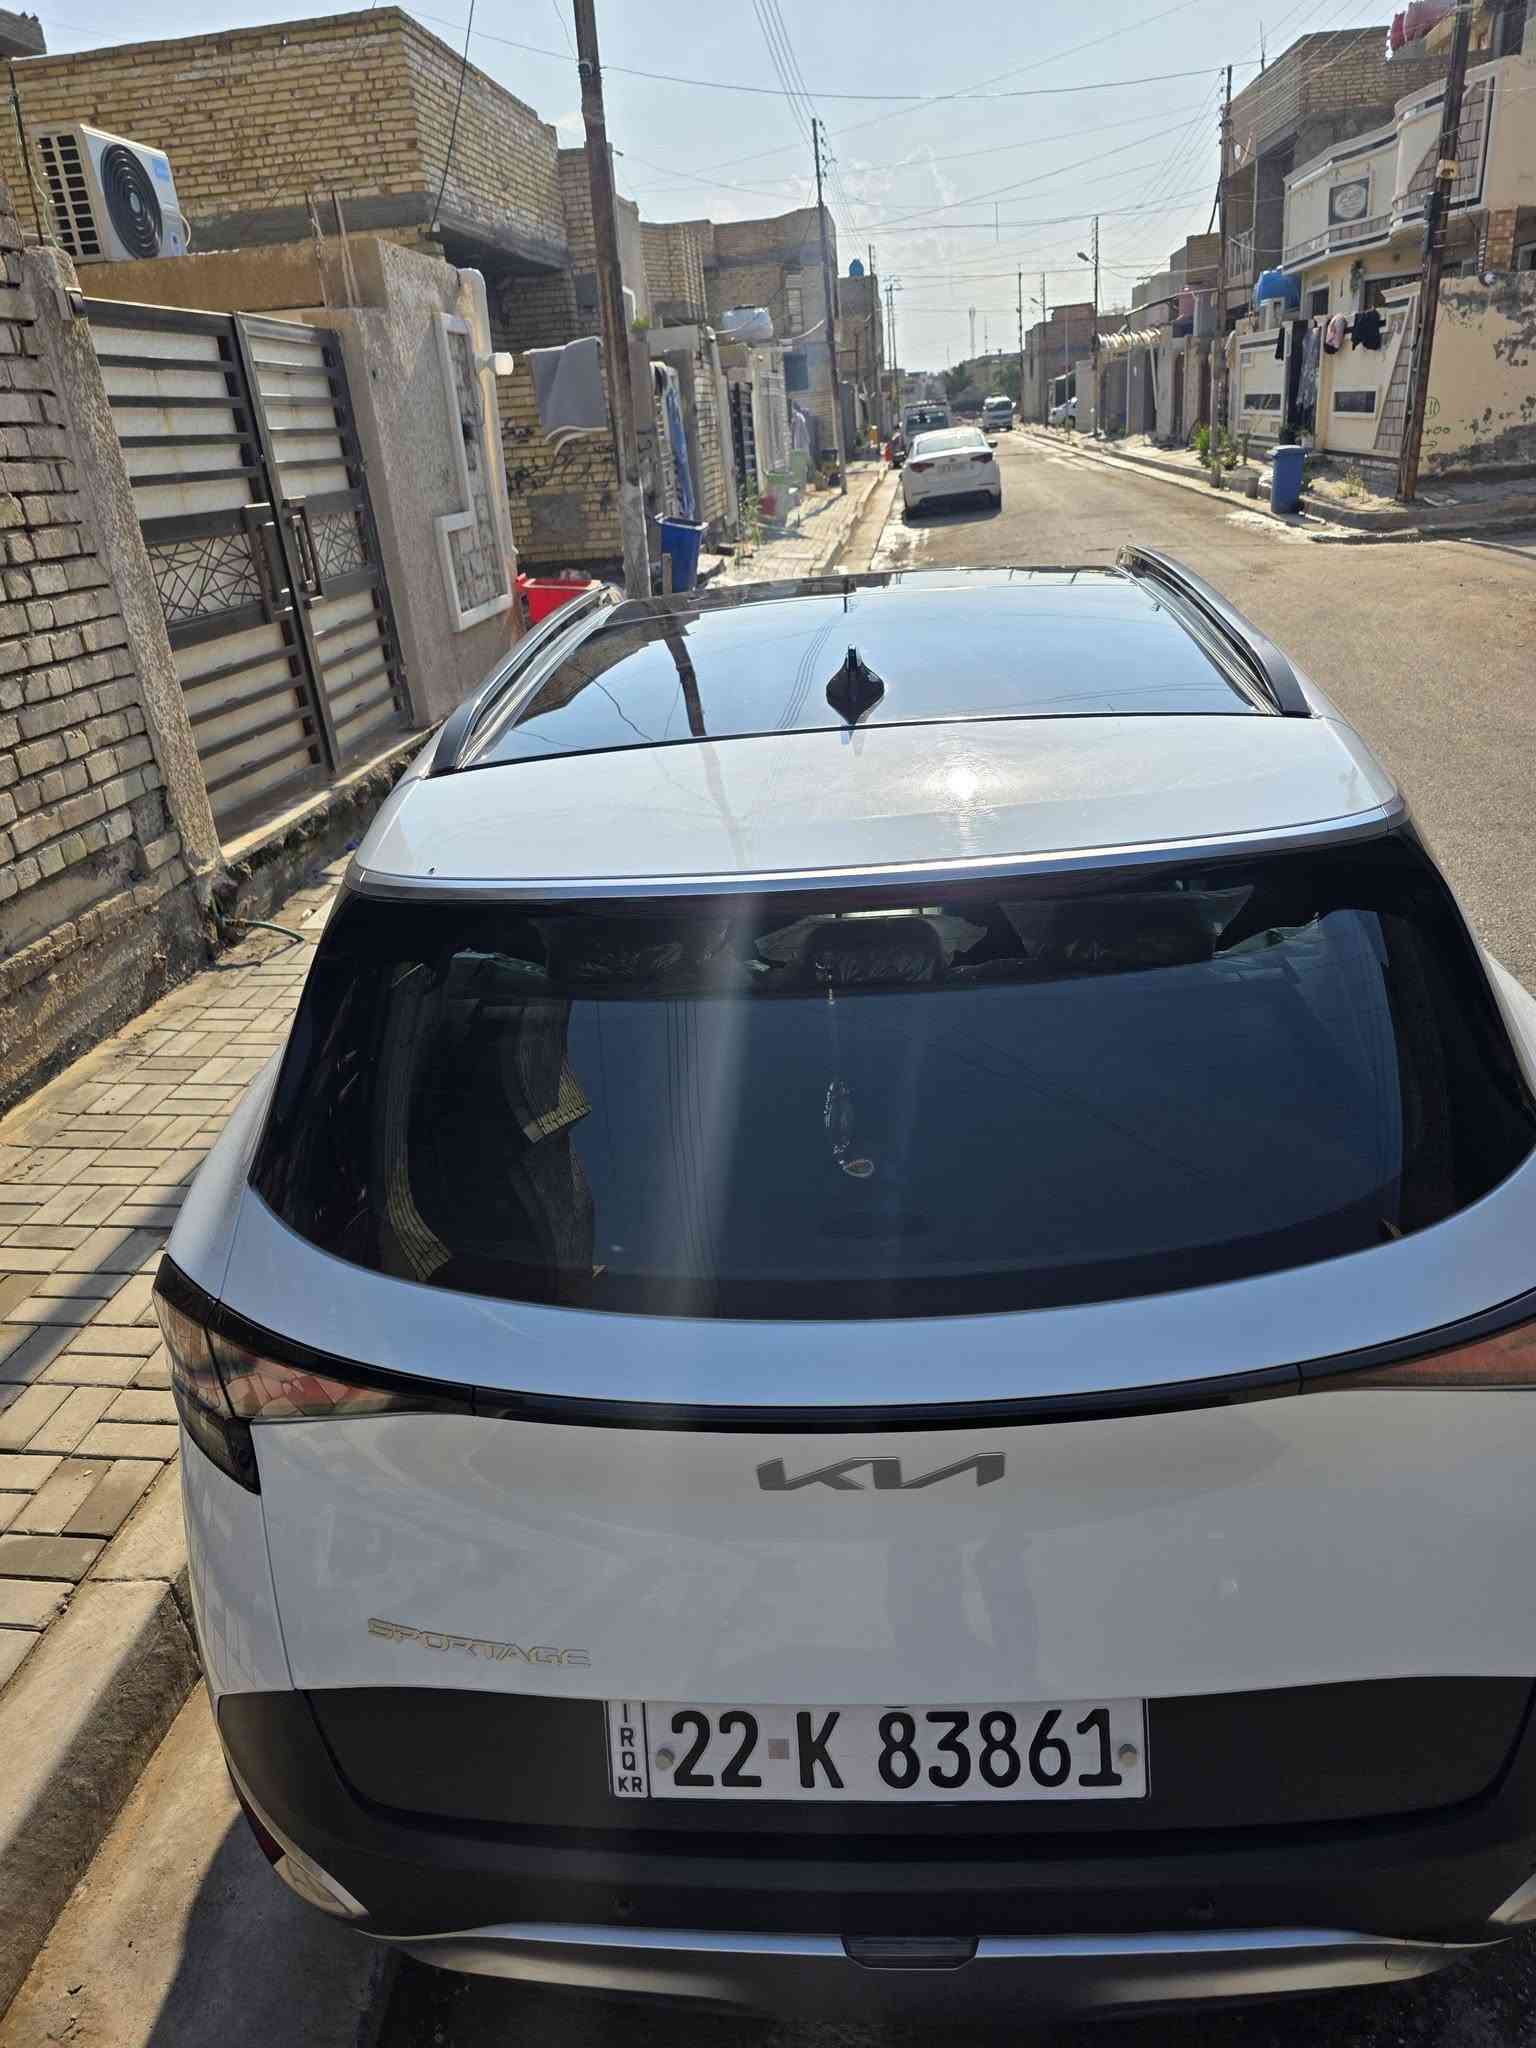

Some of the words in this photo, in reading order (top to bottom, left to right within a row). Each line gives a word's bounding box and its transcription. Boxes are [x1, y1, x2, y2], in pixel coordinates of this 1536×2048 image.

[757, 1451, 1005, 1491] KIA
[368, 1617, 592, 1668] SPORTAGE
[670, 1710, 762, 1788] 22
[796, 1711, 845, 1789] K
[877, 1708, 1123, 1789] 83861
[618, 1776, 642, 1792] KR
